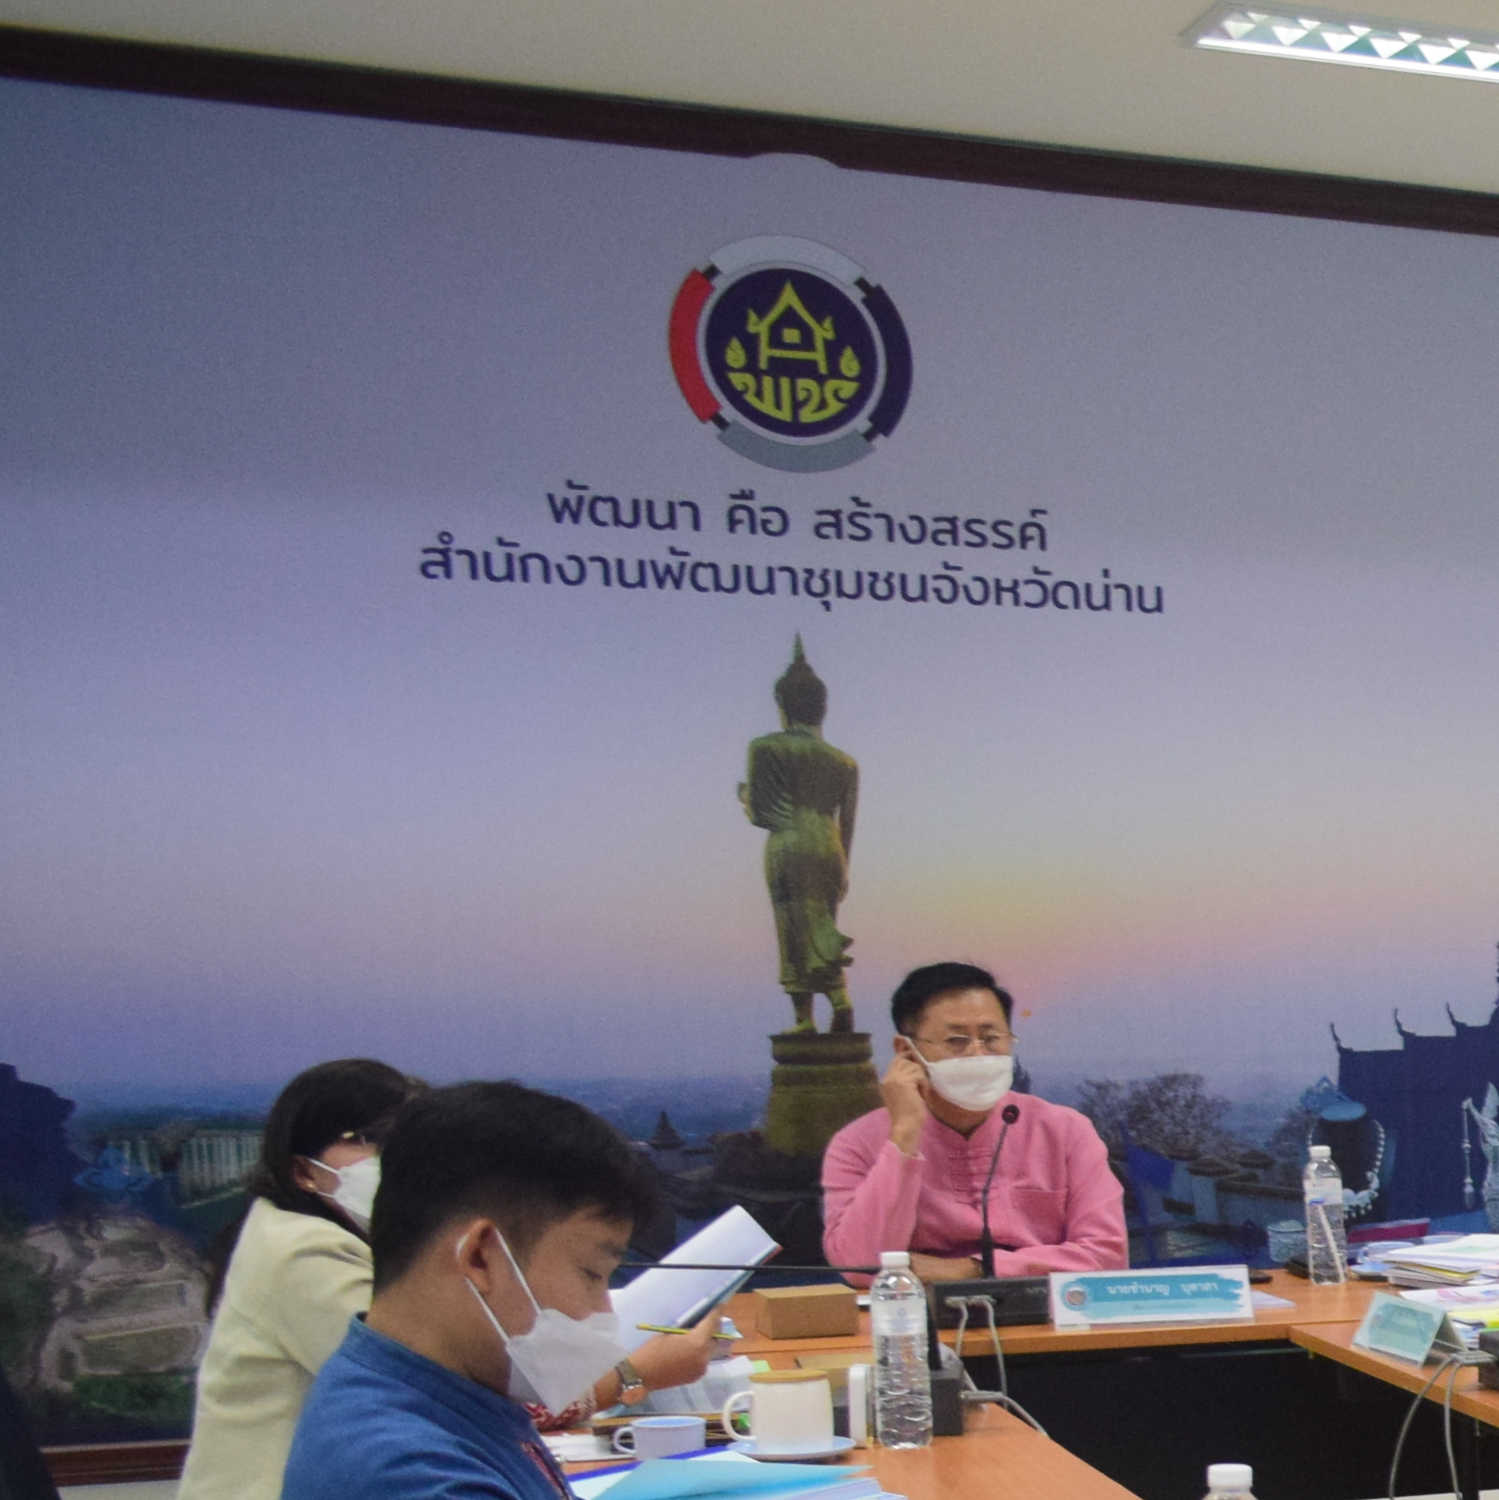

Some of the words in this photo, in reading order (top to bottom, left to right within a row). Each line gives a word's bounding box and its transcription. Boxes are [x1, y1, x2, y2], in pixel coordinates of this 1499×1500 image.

[547, 479, 701, 533] พัฒนา
[727, 488, 790, 538] คือ
[813, 496, 1048, 552] สร้างสรรค์
[419, 530, 1164, 615] สำนักงานพัฒนาชุมชนจังหวัดน่าน
